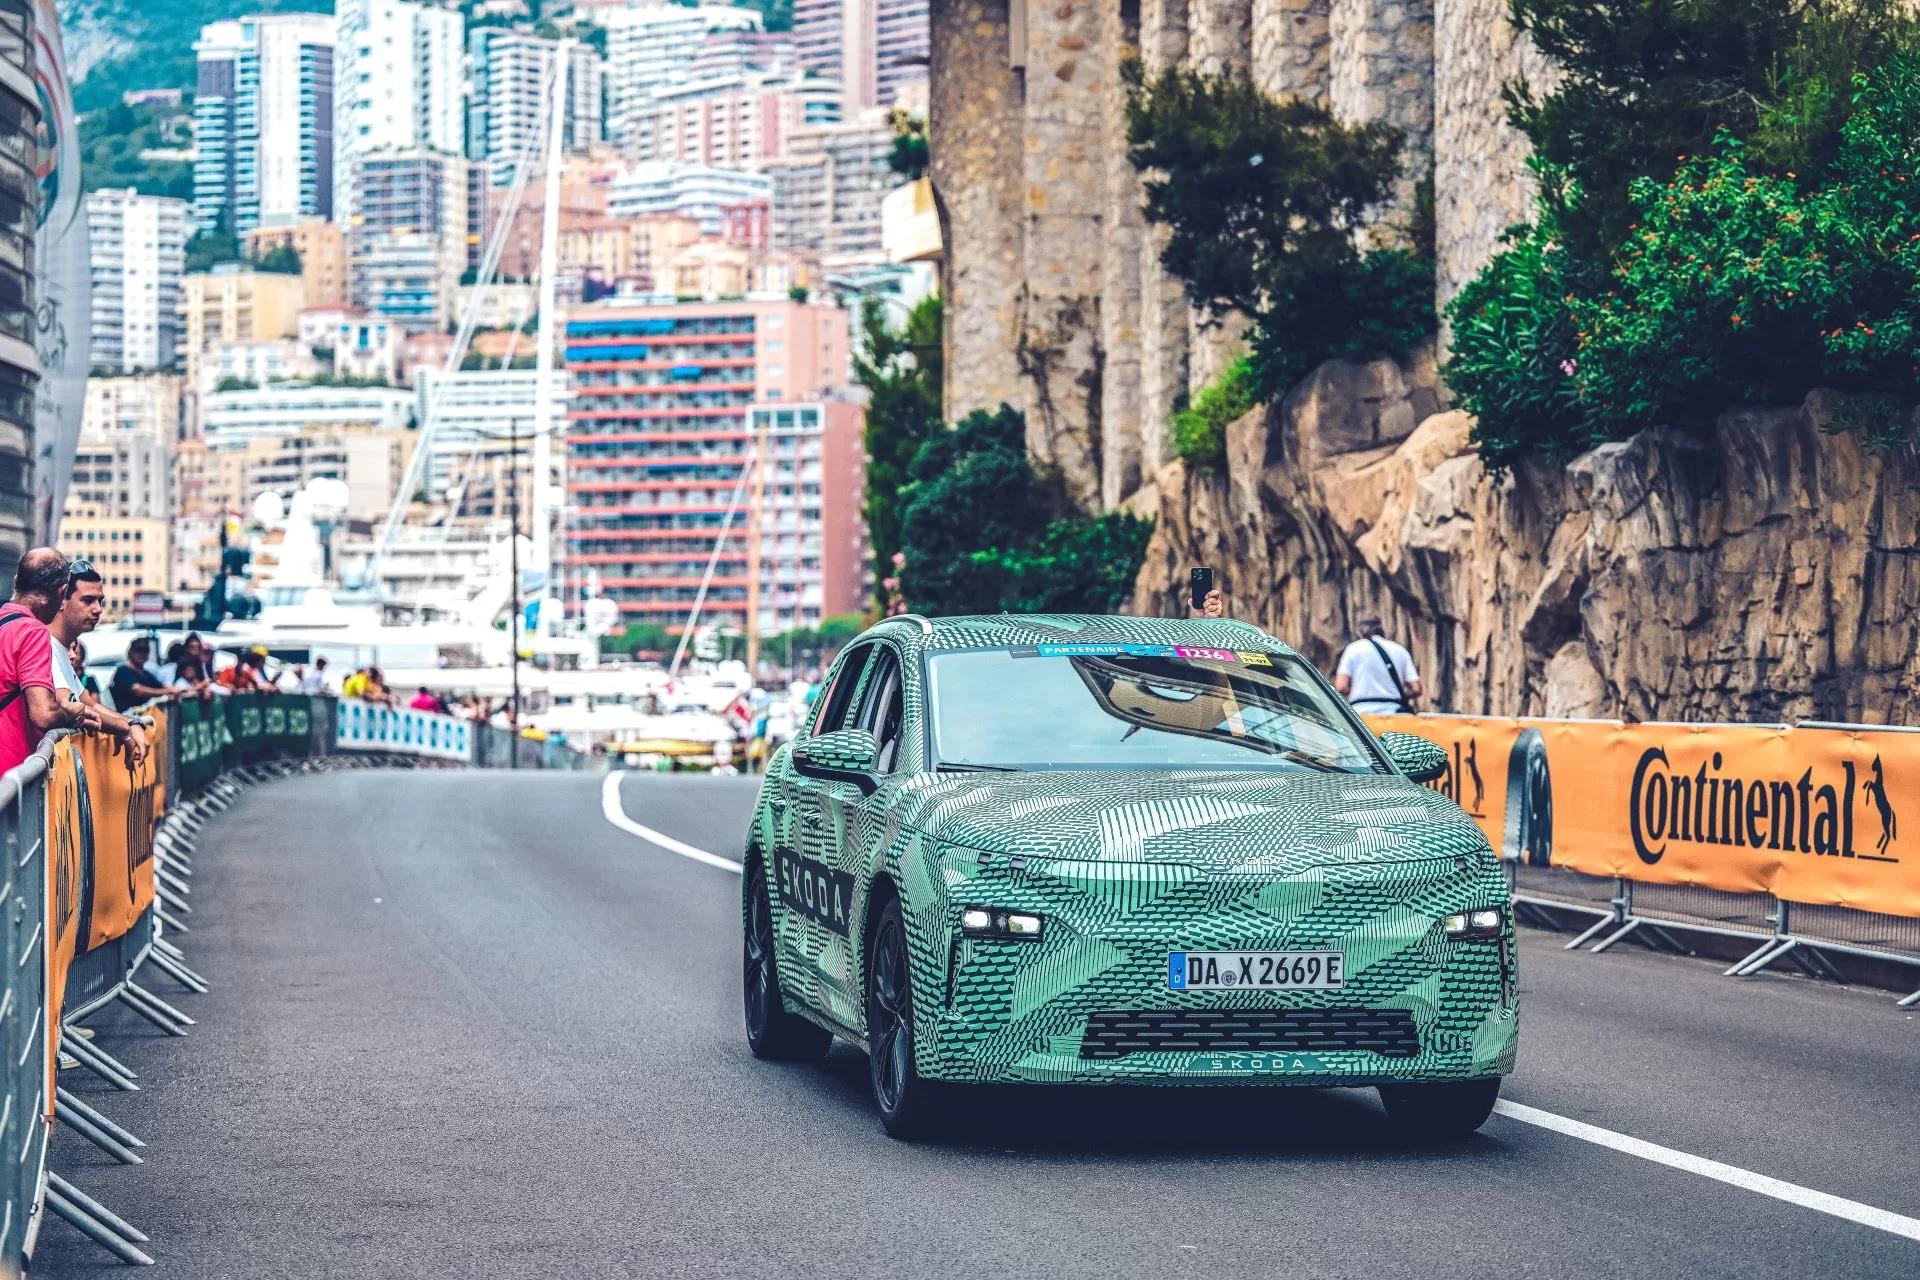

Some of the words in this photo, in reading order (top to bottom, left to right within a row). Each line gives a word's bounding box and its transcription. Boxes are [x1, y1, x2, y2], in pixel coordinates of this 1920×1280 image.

[1044, 646, 1125, 654] PARTENAIRE
[1630, 744, 1856, 865] Continental
[1187, 957, 1220, 985] DA
